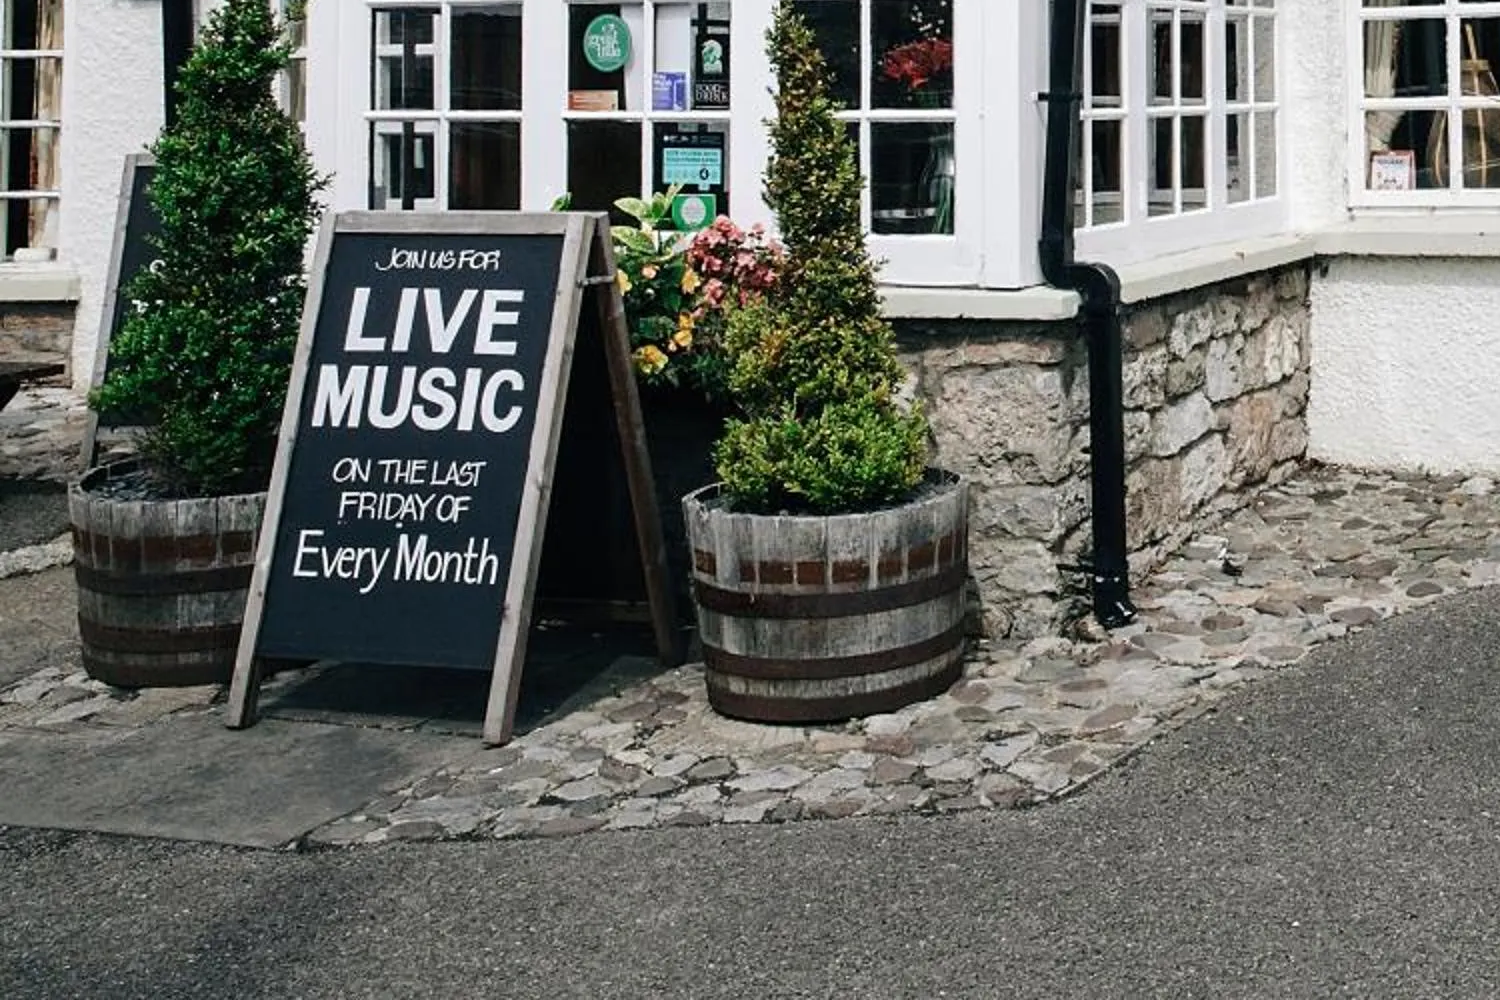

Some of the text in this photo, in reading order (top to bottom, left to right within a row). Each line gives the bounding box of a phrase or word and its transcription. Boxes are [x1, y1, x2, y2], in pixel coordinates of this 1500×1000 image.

[375, 248, 501, 271] JOIN US FOR
[343, 286, 525, 356] LIVE
[311, 364, 525, 433] MUSIC
[332, 457, 487, 487] ON THE LAST
[338, 491, 472, 524] FRIDAY OF
[292, 528, 500, 595] Every Month
